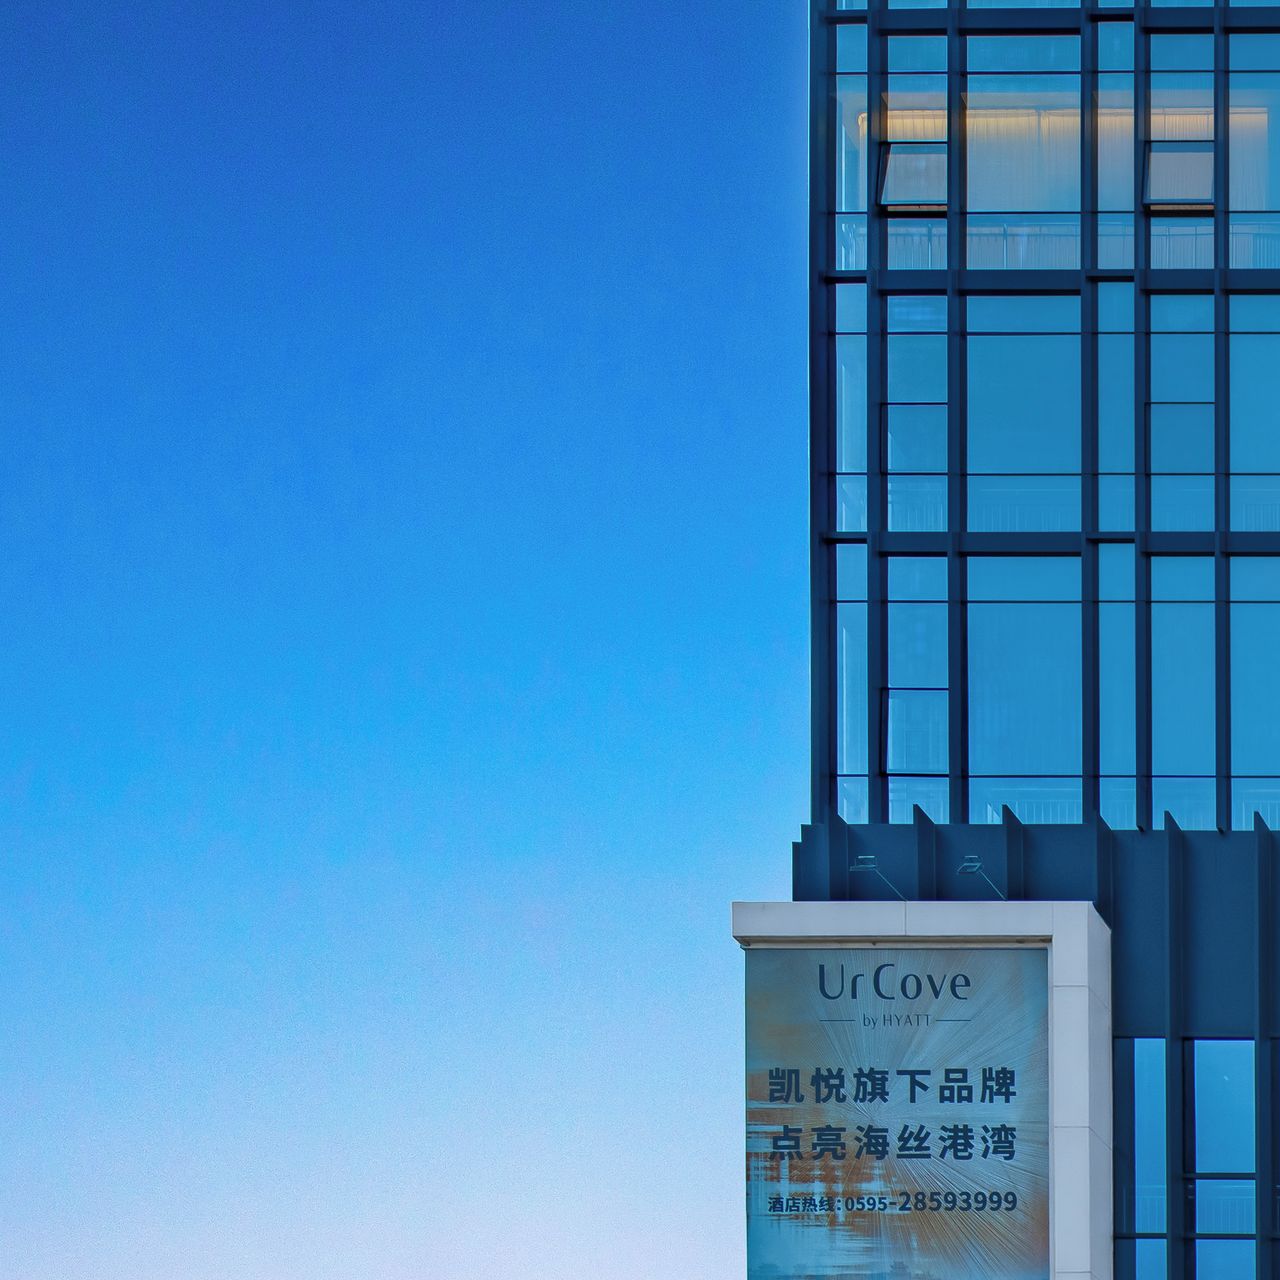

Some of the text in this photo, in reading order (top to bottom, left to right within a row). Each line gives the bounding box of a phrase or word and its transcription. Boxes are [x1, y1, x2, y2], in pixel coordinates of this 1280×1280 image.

[863, 1013, 931, 1029] by HYATT
[768, 1067, 1017, 1104] 凯悦旗下品牌
[768, 1124, 1018, 1161] 点亮海丝港湾
